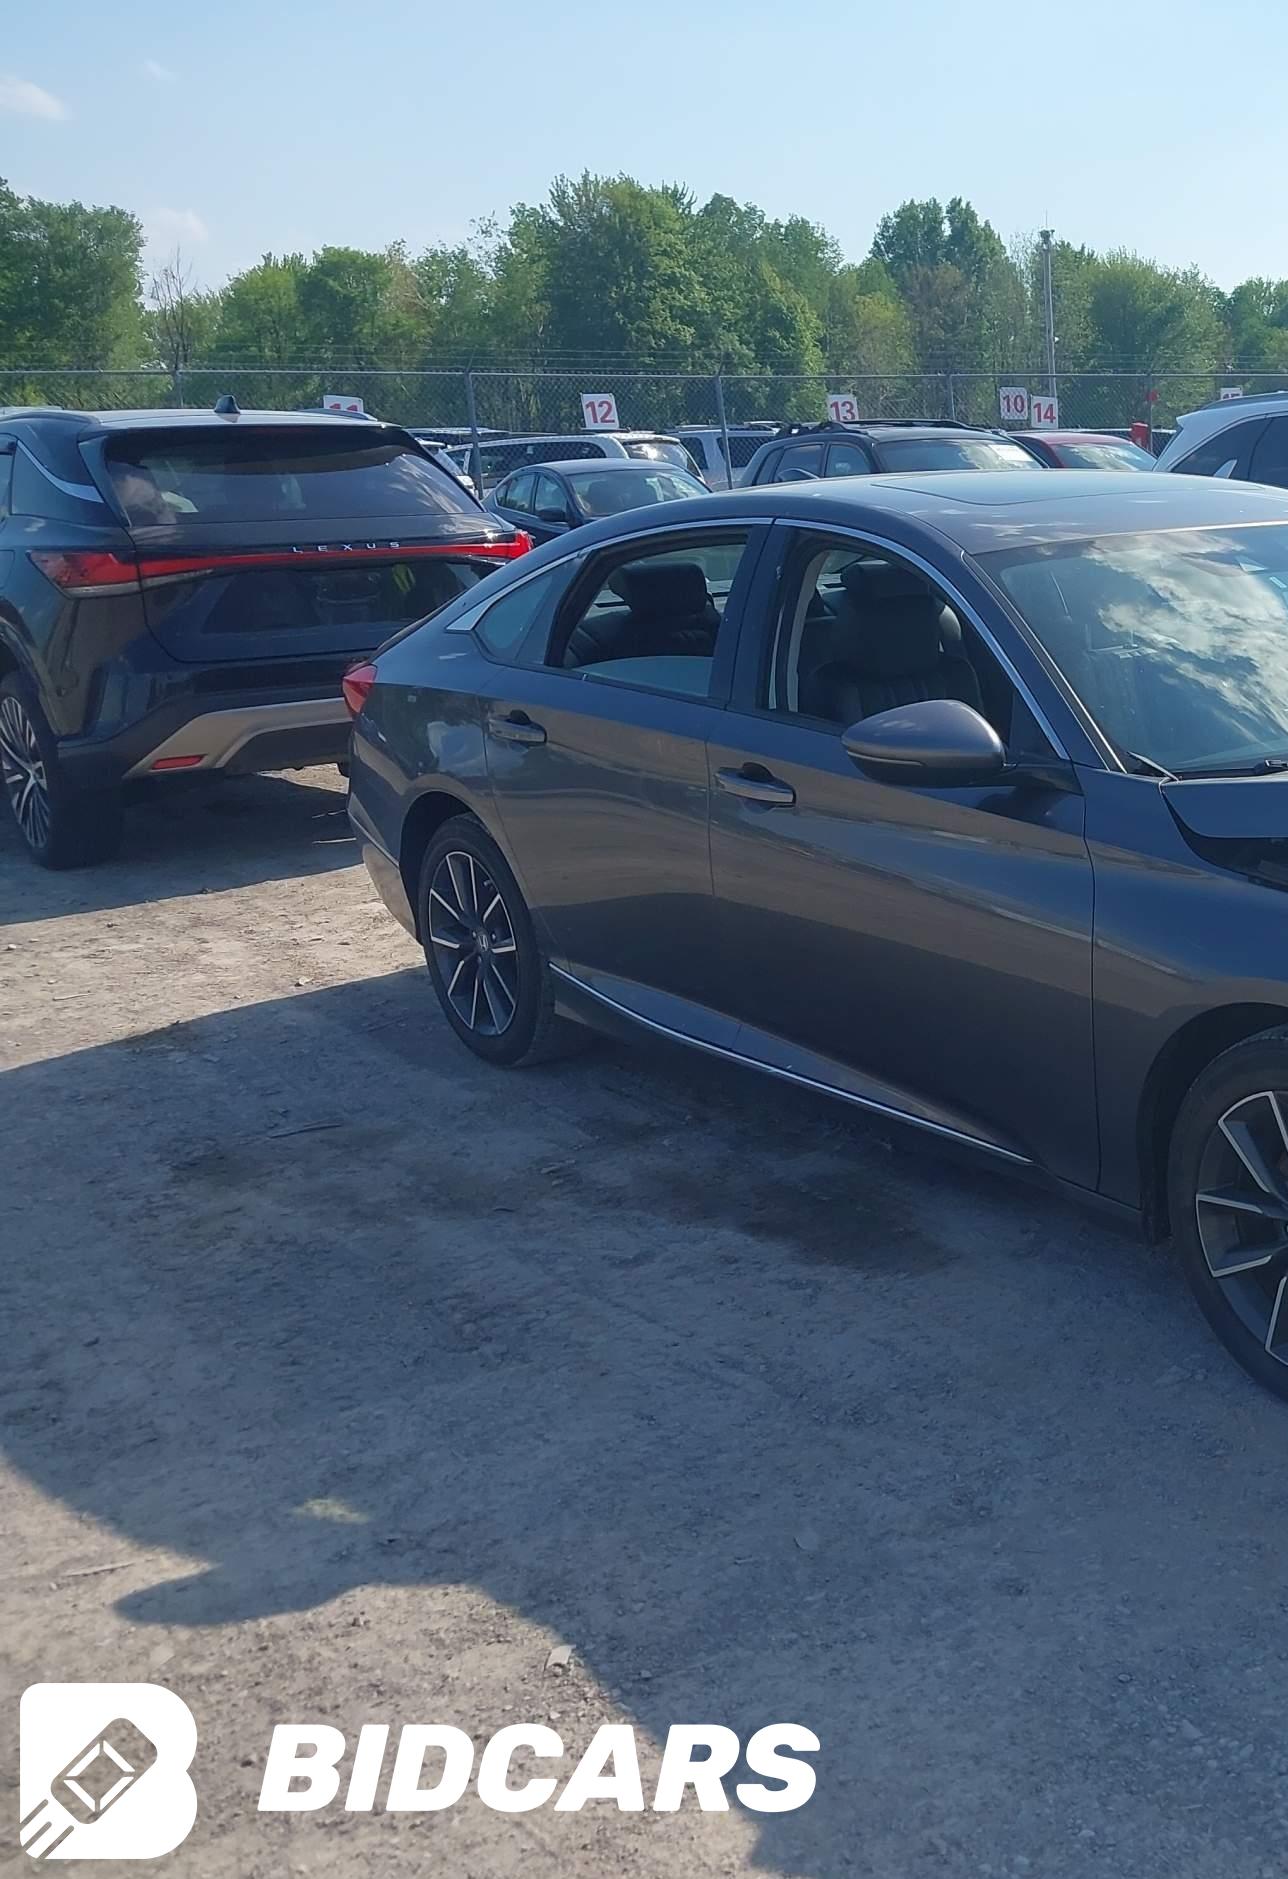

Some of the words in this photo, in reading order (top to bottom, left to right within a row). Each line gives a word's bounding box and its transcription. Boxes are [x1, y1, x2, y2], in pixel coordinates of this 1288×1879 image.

[585, 400, 615, 423] 12
[830, 400, 856, 422] 13
[1003, 395, 1025, 413] 10
[1033, 402, 1056, 423] 14
[292, 541, 400, 554] LEXUS
